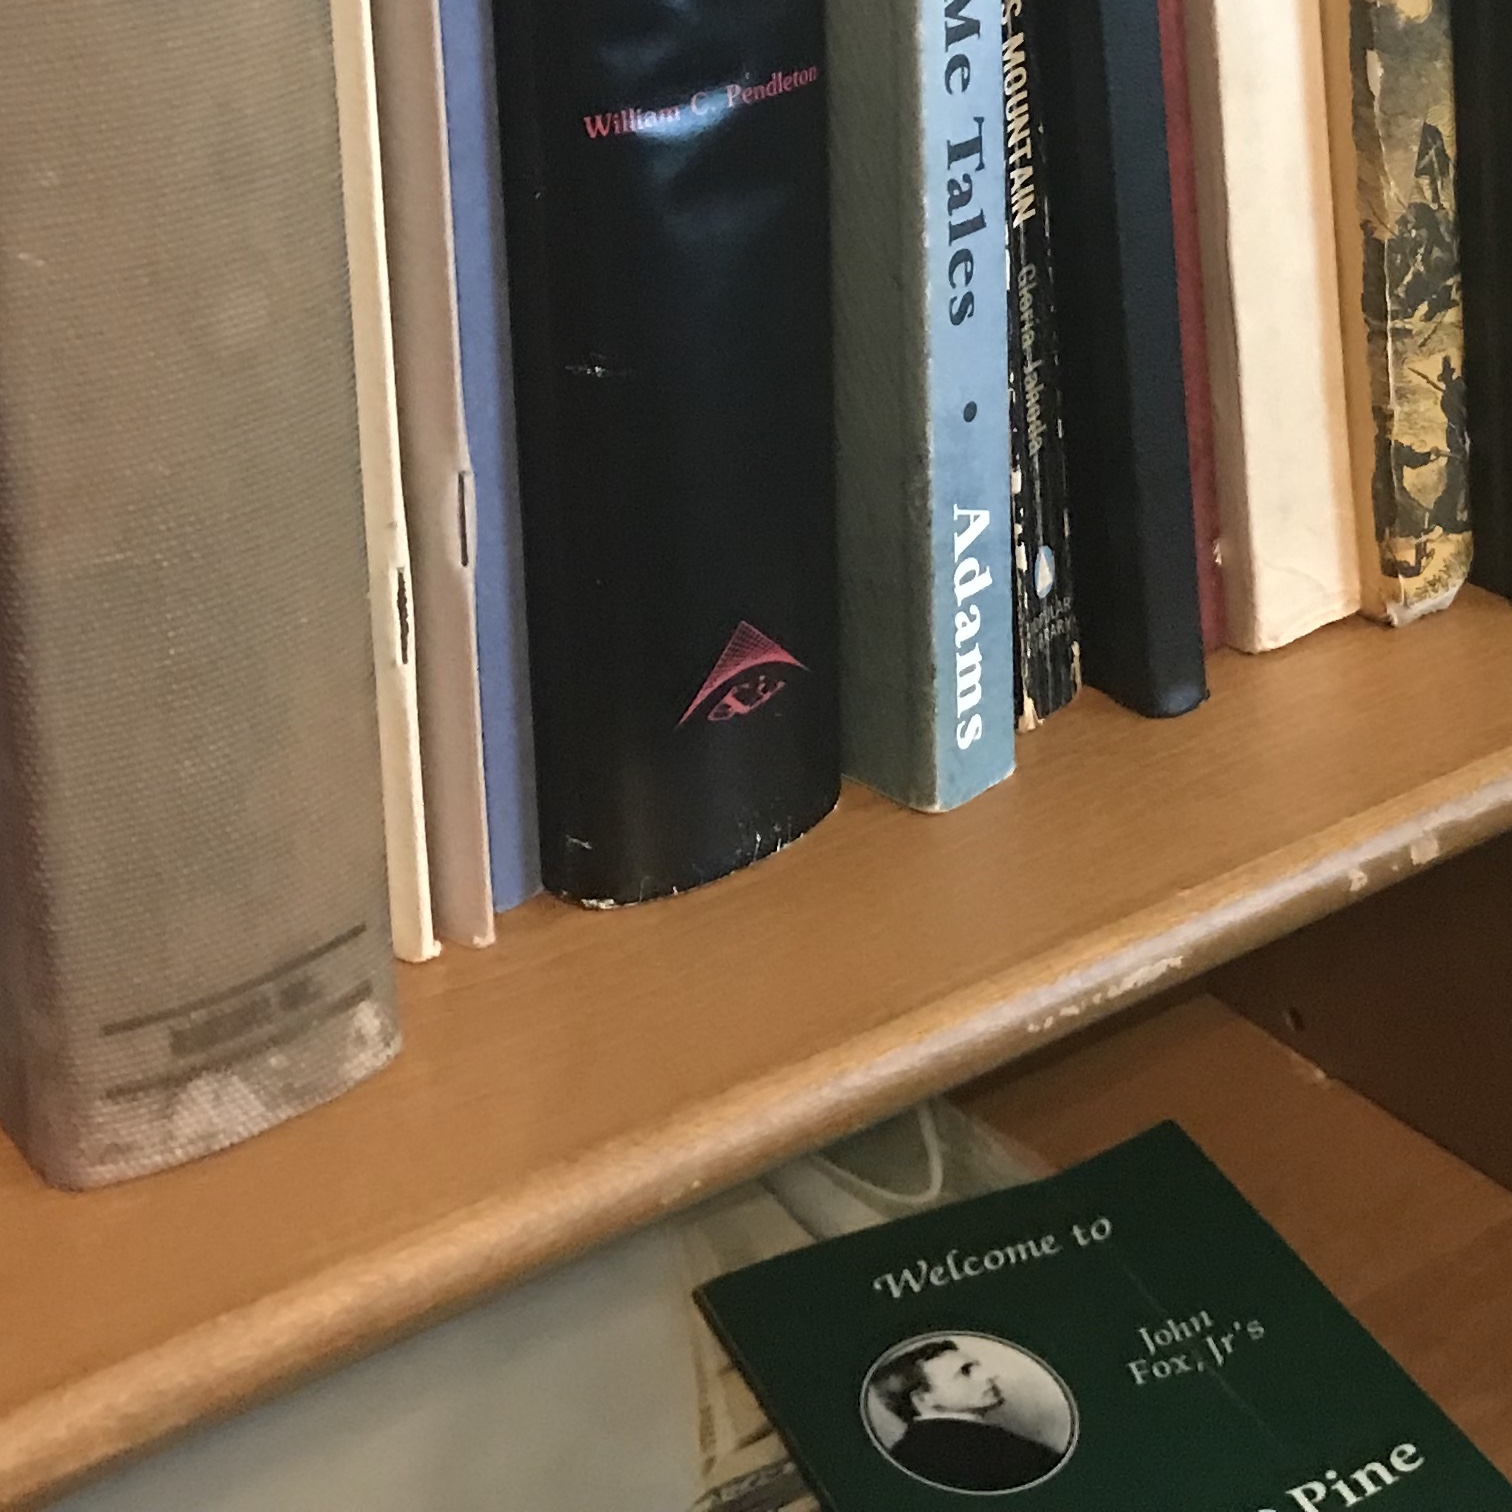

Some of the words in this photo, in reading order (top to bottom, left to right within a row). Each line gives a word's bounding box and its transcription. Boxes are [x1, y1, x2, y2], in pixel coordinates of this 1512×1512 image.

[583, 104, 681, 139] William
[725, 64, 818, 109] Pendleton
[1002, 31, 1037, 229] MOUNTAIN
[945, 116, 988, 327] Tales
[953, 503, 993, 750] Adams
[873, 1230, 1062, 1301] Welcome
[1072, 1213, 1114, 1248] to
[1137, 1309, 1214, 1357] John
[1285, 1442, 1426, 1512] Pine
